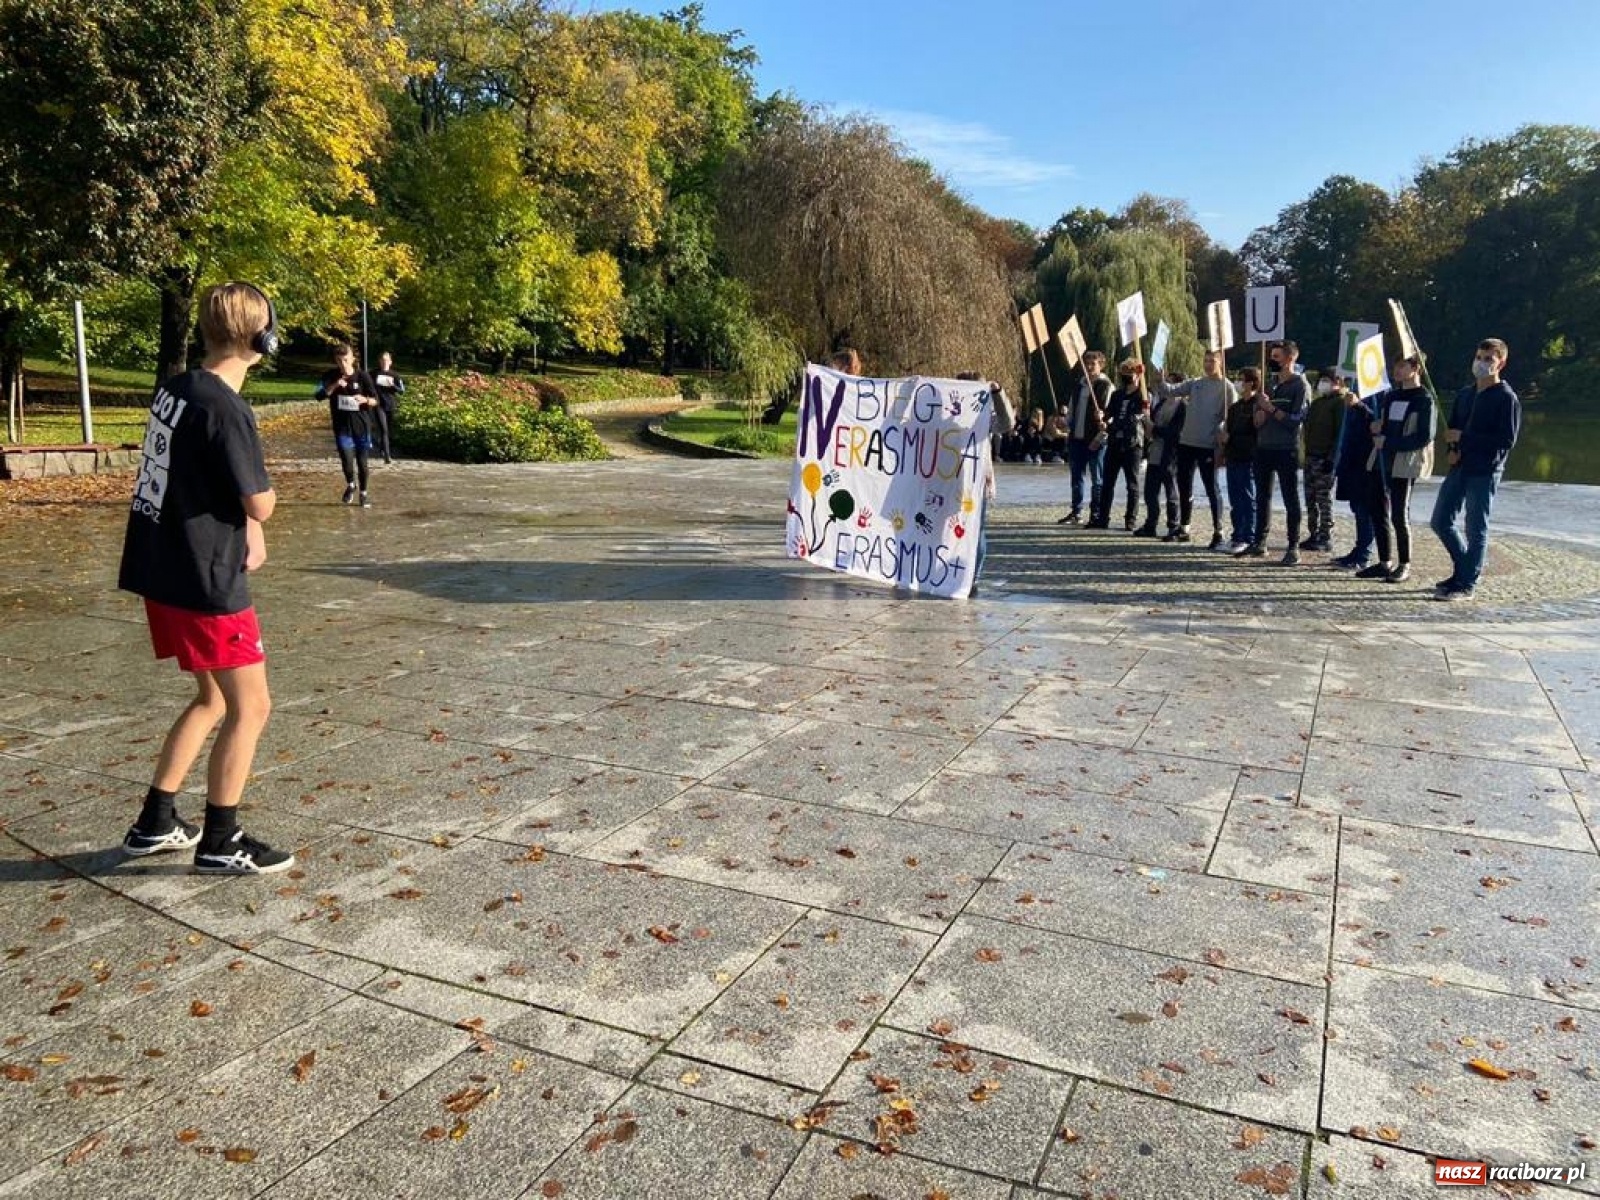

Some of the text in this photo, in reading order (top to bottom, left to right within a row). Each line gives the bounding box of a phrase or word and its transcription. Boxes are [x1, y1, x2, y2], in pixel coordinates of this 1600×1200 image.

[1252, 295, 1279, 333] U
[856, 379, 943, 423] BIEG
[834, 425, 979, 482] ERASMUSA
[835, 532, 967, 588] ERASMUS+
